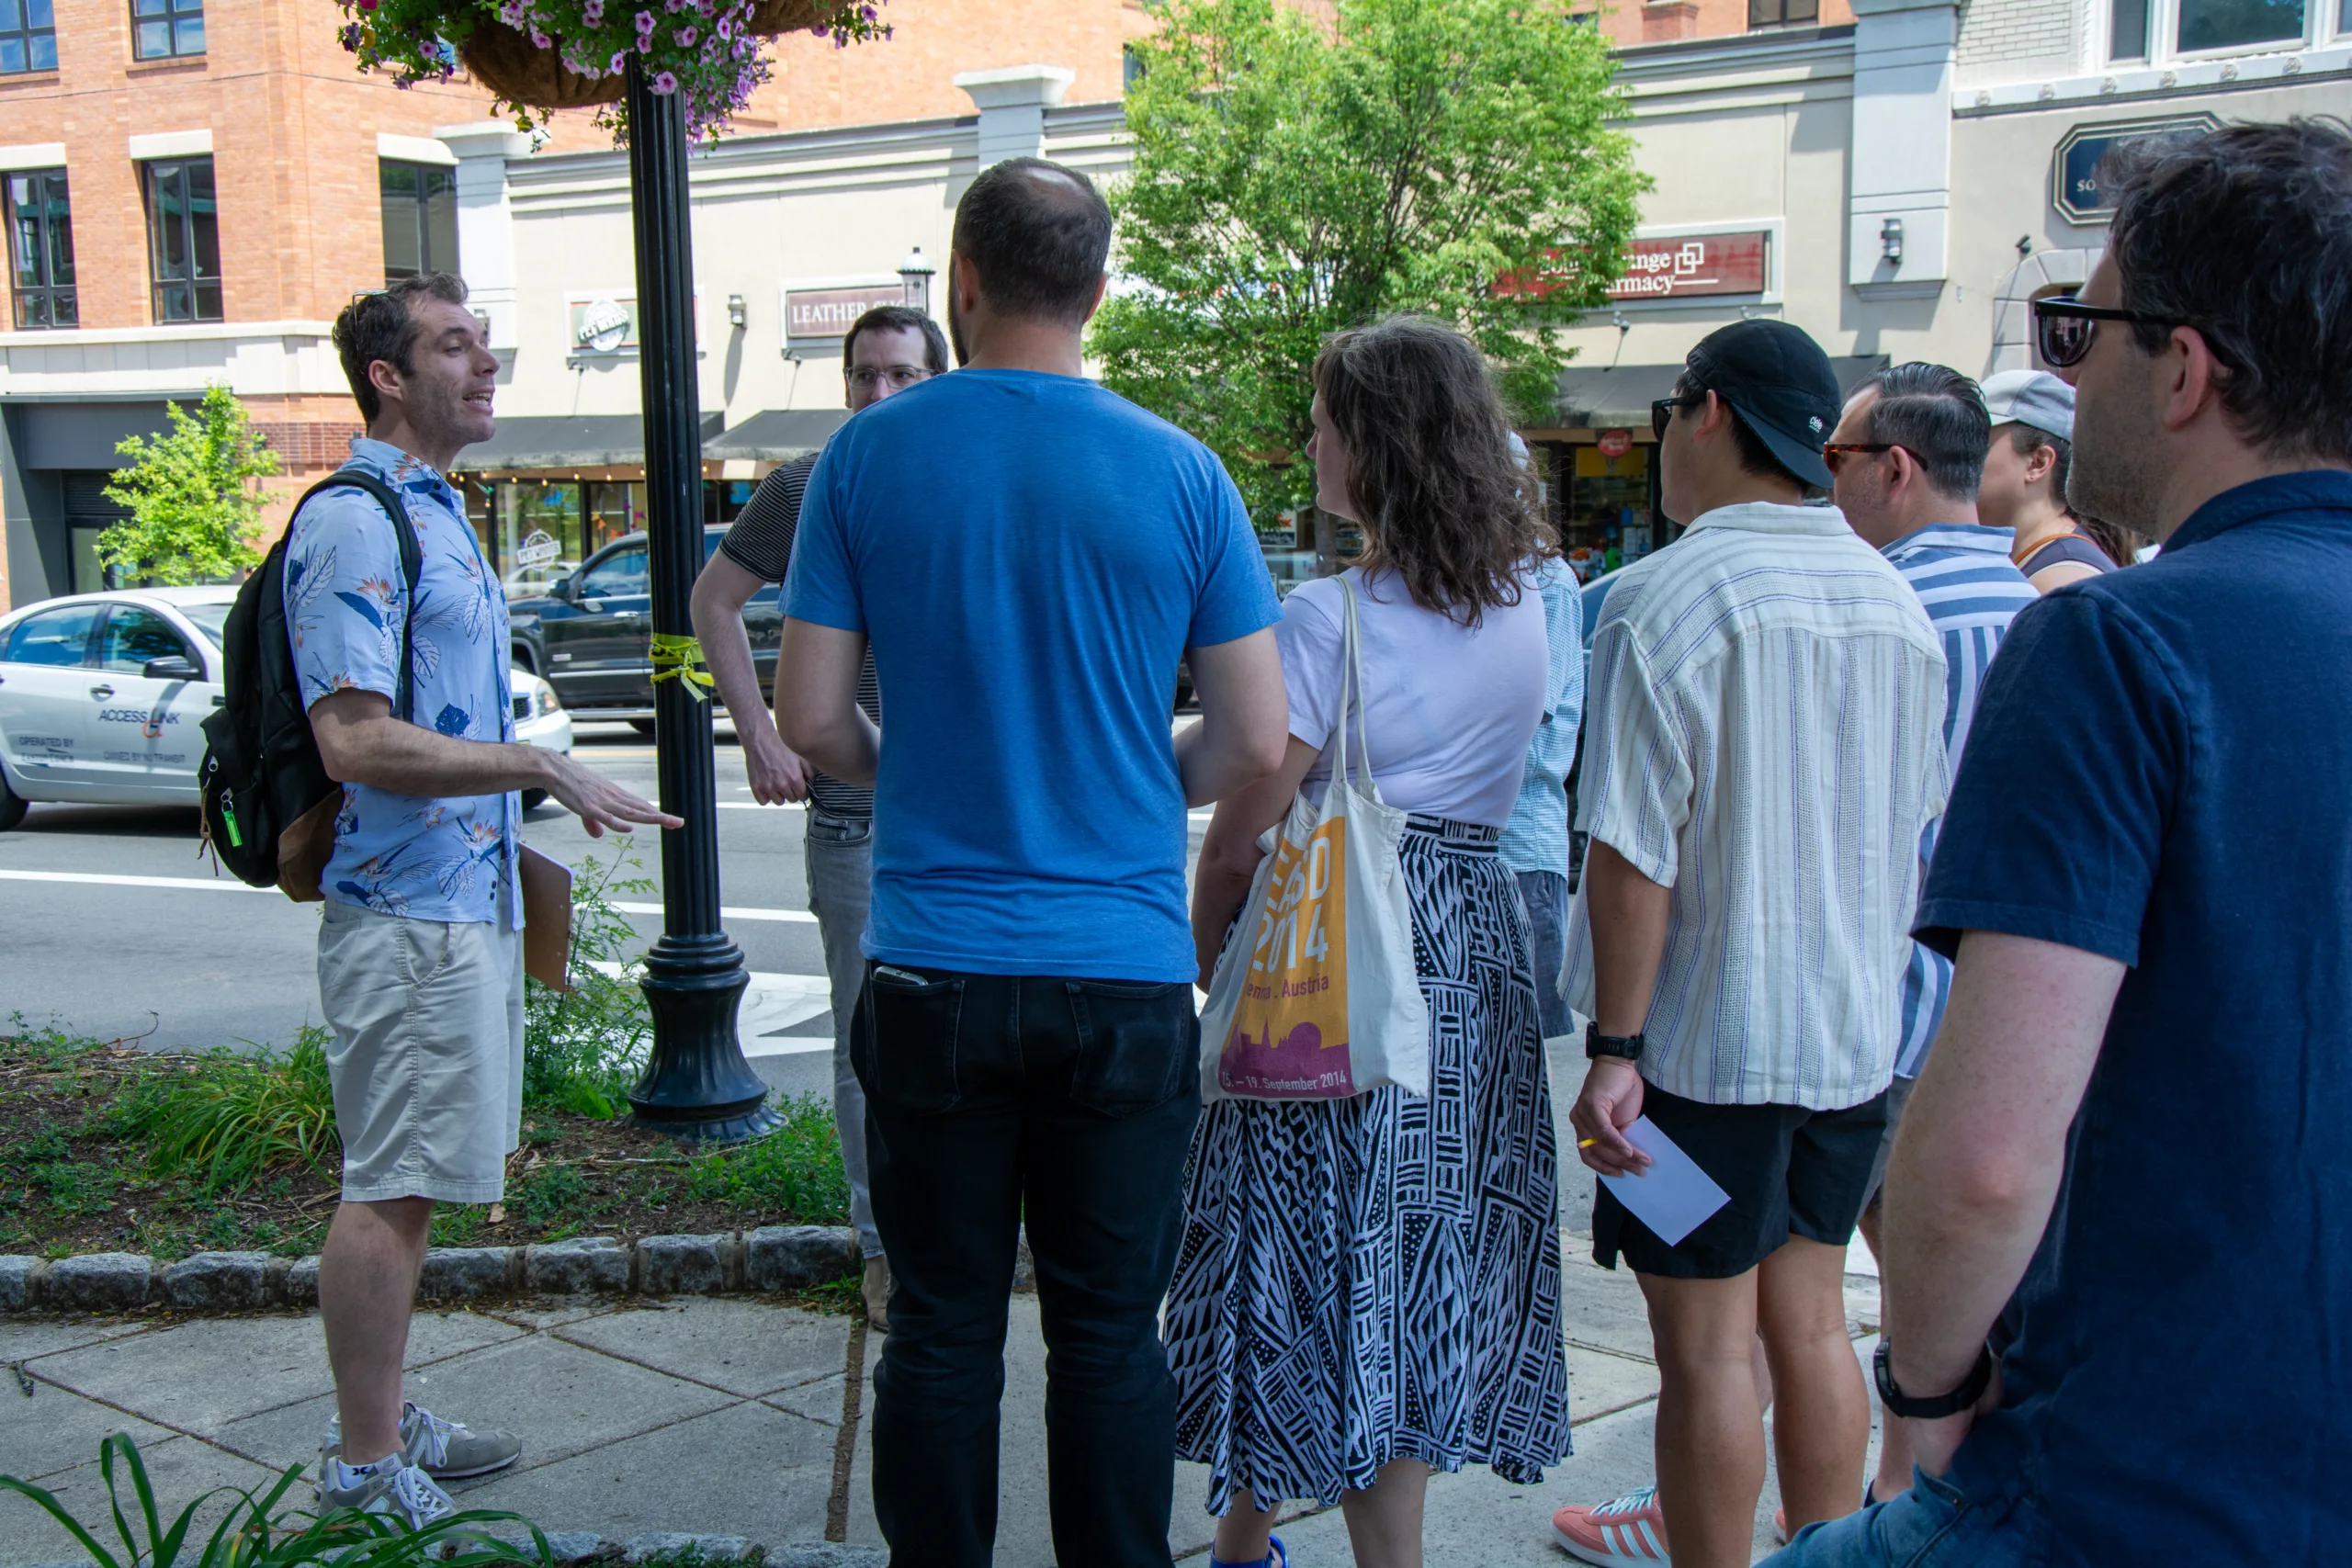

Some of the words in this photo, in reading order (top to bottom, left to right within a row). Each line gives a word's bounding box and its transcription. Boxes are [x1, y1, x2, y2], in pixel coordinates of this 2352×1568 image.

[97, 708, 148, 723] ACCESS
[19, 736, 62, 747] OPERATED
[62, 738, 74, 748] BY
[1251, 903, 1329, 974] 2014
[1246, 980, 1272, 1000] enna
[1281, 973, 1329, 999] Austria
[1262, 1077, 1317, 1092] September
[1319, 1069, 1347, 1089] 2014
